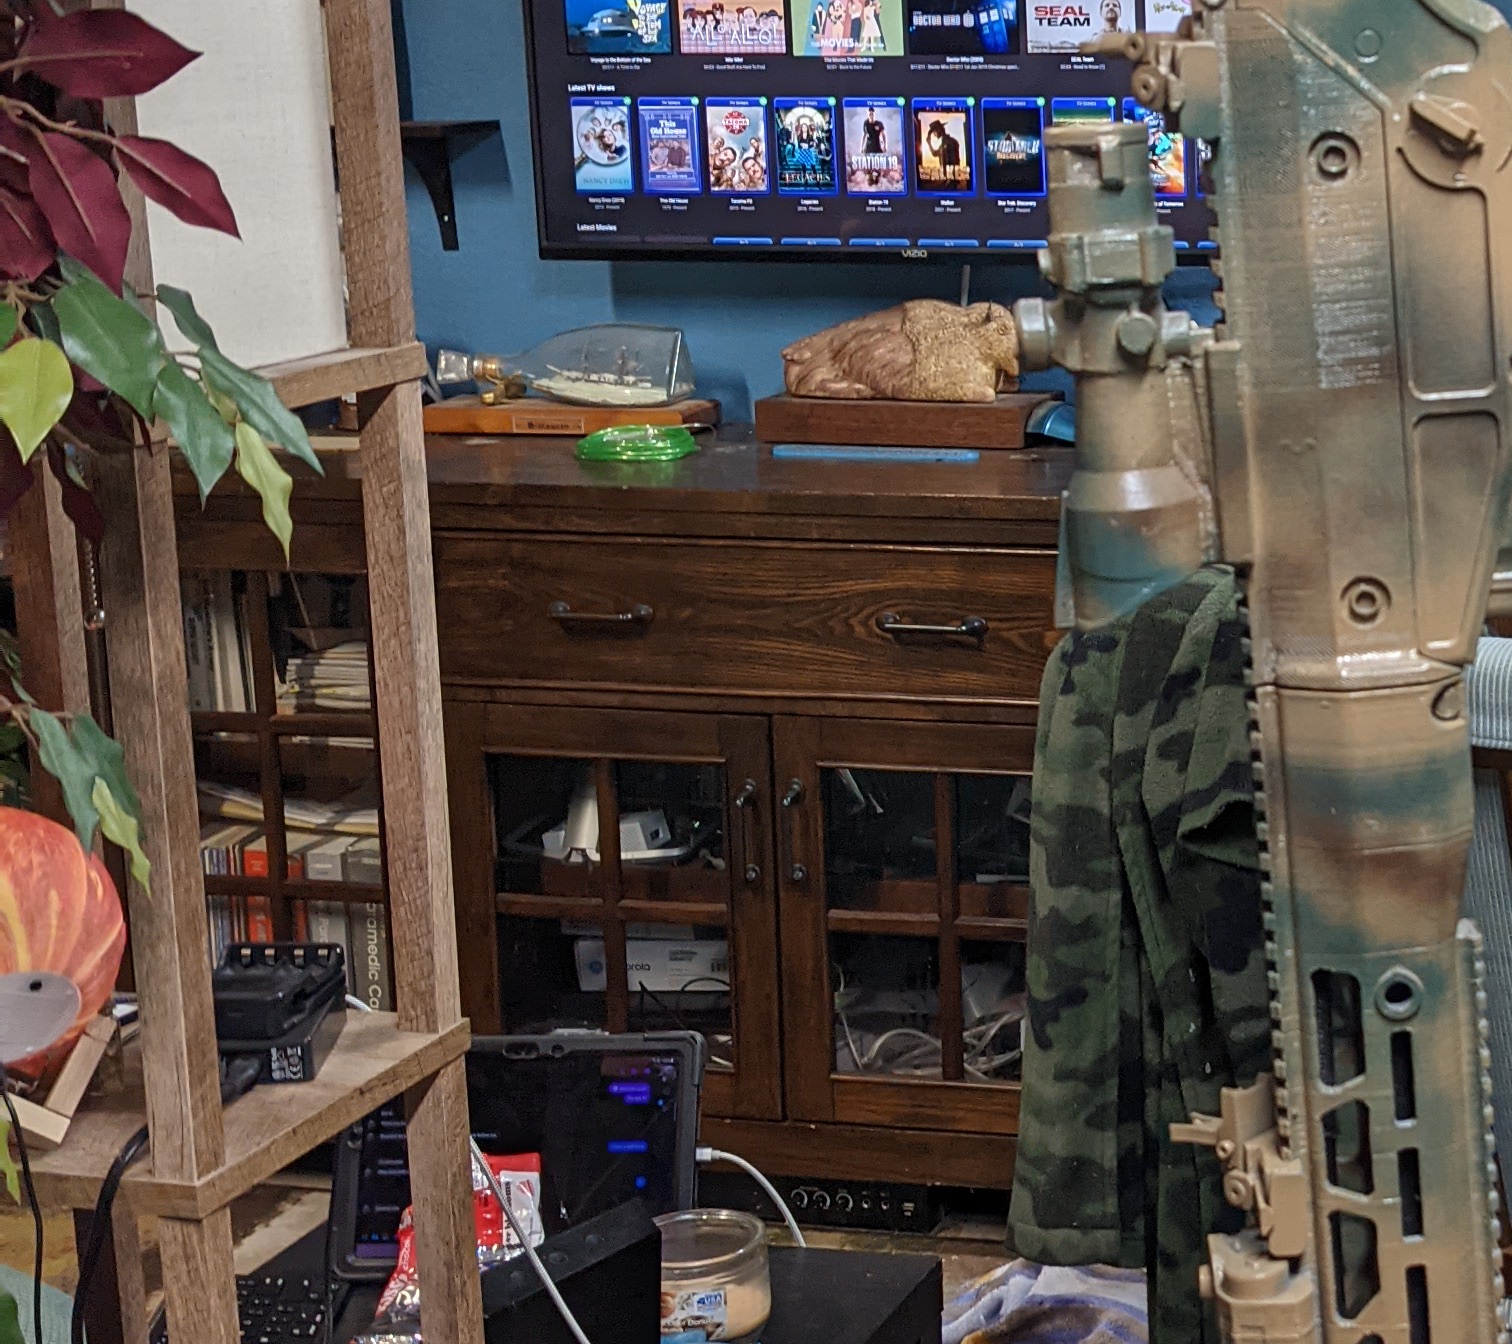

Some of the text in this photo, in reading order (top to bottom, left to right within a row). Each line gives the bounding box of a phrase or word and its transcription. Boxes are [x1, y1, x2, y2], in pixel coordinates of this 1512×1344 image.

[1034, 5, 1090, 17] SEAL
[1034, 17, 1091, 27] TEAM
[820, 38, 855, 48] MOVIES
[568, 84, 587, 92] Latest
[587, 84, 596, 92] TV
[851, 155, 898, 170] STATION 19
[901, 248, 928, 258] VIZIO
[365, 902, 381, 981] aramedic
